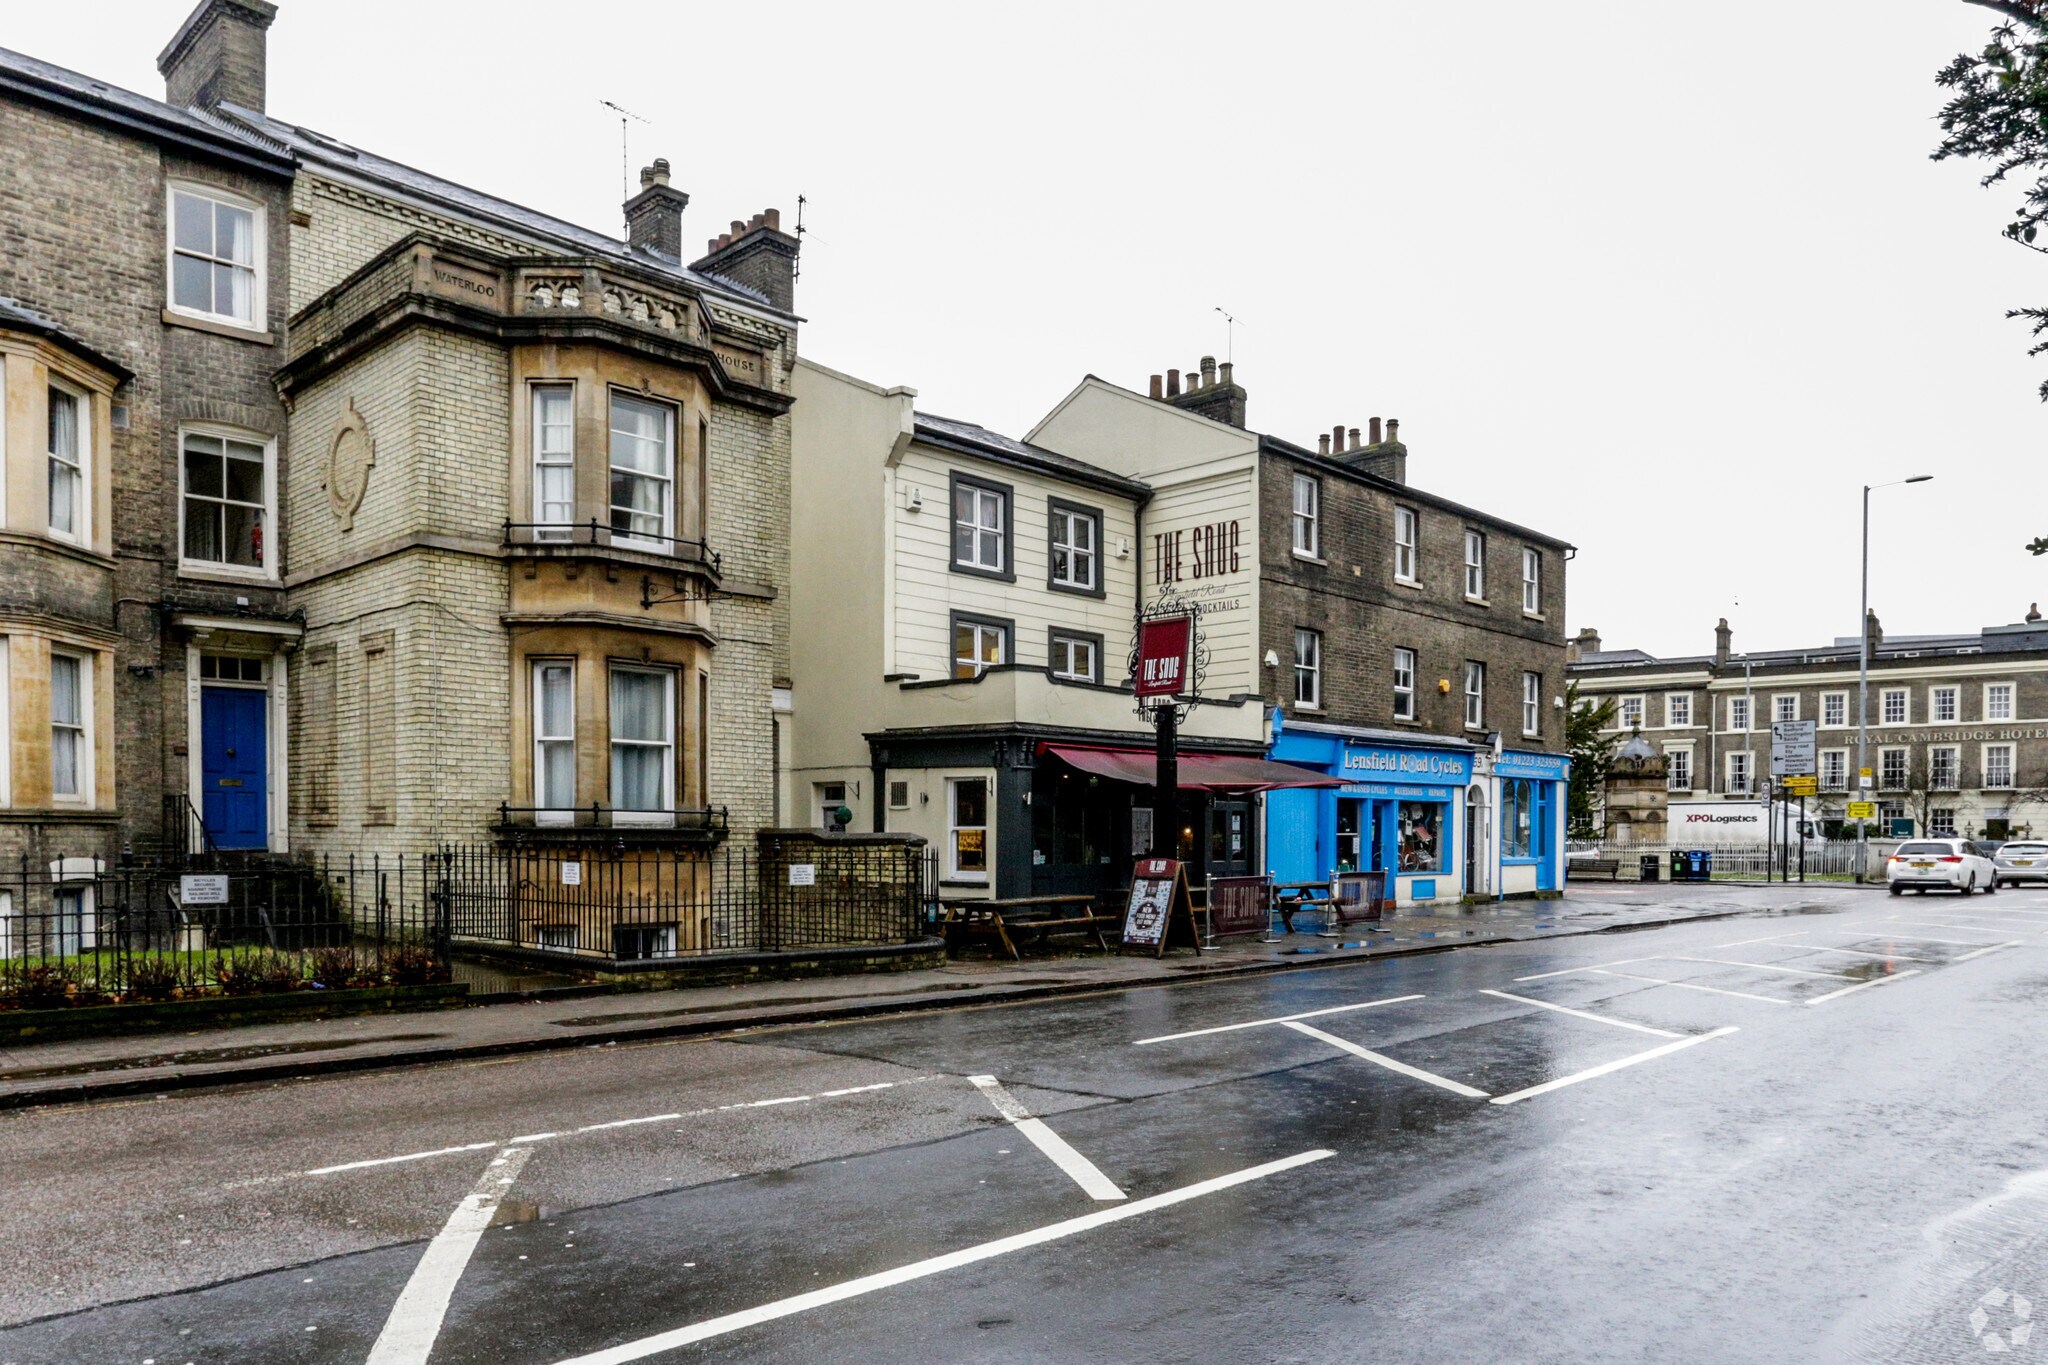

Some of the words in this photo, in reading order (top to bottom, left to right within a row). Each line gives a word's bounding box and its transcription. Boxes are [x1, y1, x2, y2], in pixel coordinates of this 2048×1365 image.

[434, 269, 495, 297] WATERLOO
[717, 352, 755, 372] HOUSE
[1154, 530, 1183, 585] THE
[1193, 520, 1239, 580] SNUG
[1144, 658, 1157, 681] THE
[1159, 656, 1180, 680] SNUG
[1898, 730, 1995, 743] CAMBRIDGE
[1344, 749, 1396, 772] Lensfield
[1400, 754, 1429, 773] Road
[1431, 755, 1463, 777] Cycles
[1513, 755, 1536, 766] 01223
[1223, 887, 1237, 919] THE
[1239, 885, 1260, 918] SNUG
